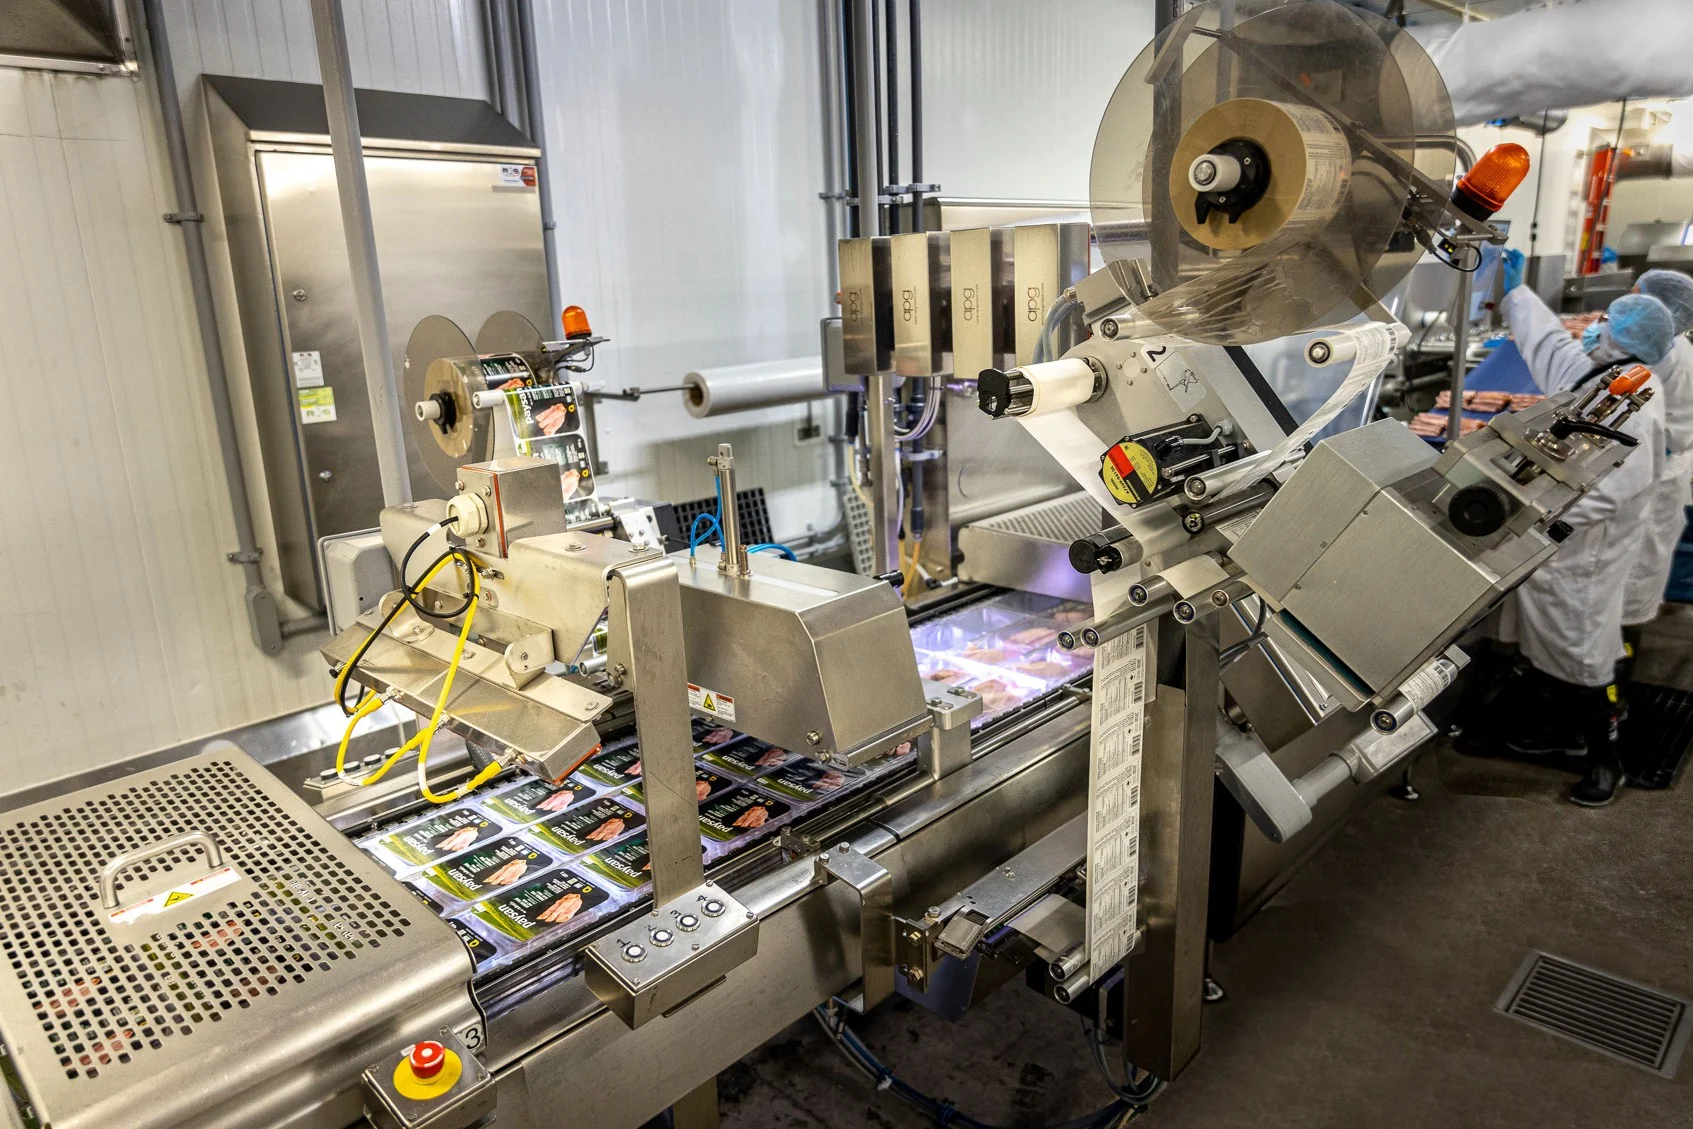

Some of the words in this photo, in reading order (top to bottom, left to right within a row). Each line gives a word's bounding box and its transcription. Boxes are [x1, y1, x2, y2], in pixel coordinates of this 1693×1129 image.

[848, 291, 860, 322] apg
[902, 289, 913, 322] apg
[963, 287, 975, 321] apg
[1027, 286, 1040, 322] apg
[1146, 345, 1167, 362] 2
[593, 763, 625, 779] paysan
[721, 755, 755, 771] paysan
[776, 778, 814, 794] paysan
[504, 798, 536, 815] paysan
[699, 815, 734, 833] paysan
[403, 835, 435, 855] paysan
[551, 826, 586, 846] paysan
[605, 857, 642, 878] paysan
[448, 868, 483, 891] paysan
[498, 904, 537, 929] paysan
[670, 909, 682, 919] 3
[644, 924, 657, 932] 2
[616, 938, 631, 948] 1
[465, 1027, 481, 1049] 3
